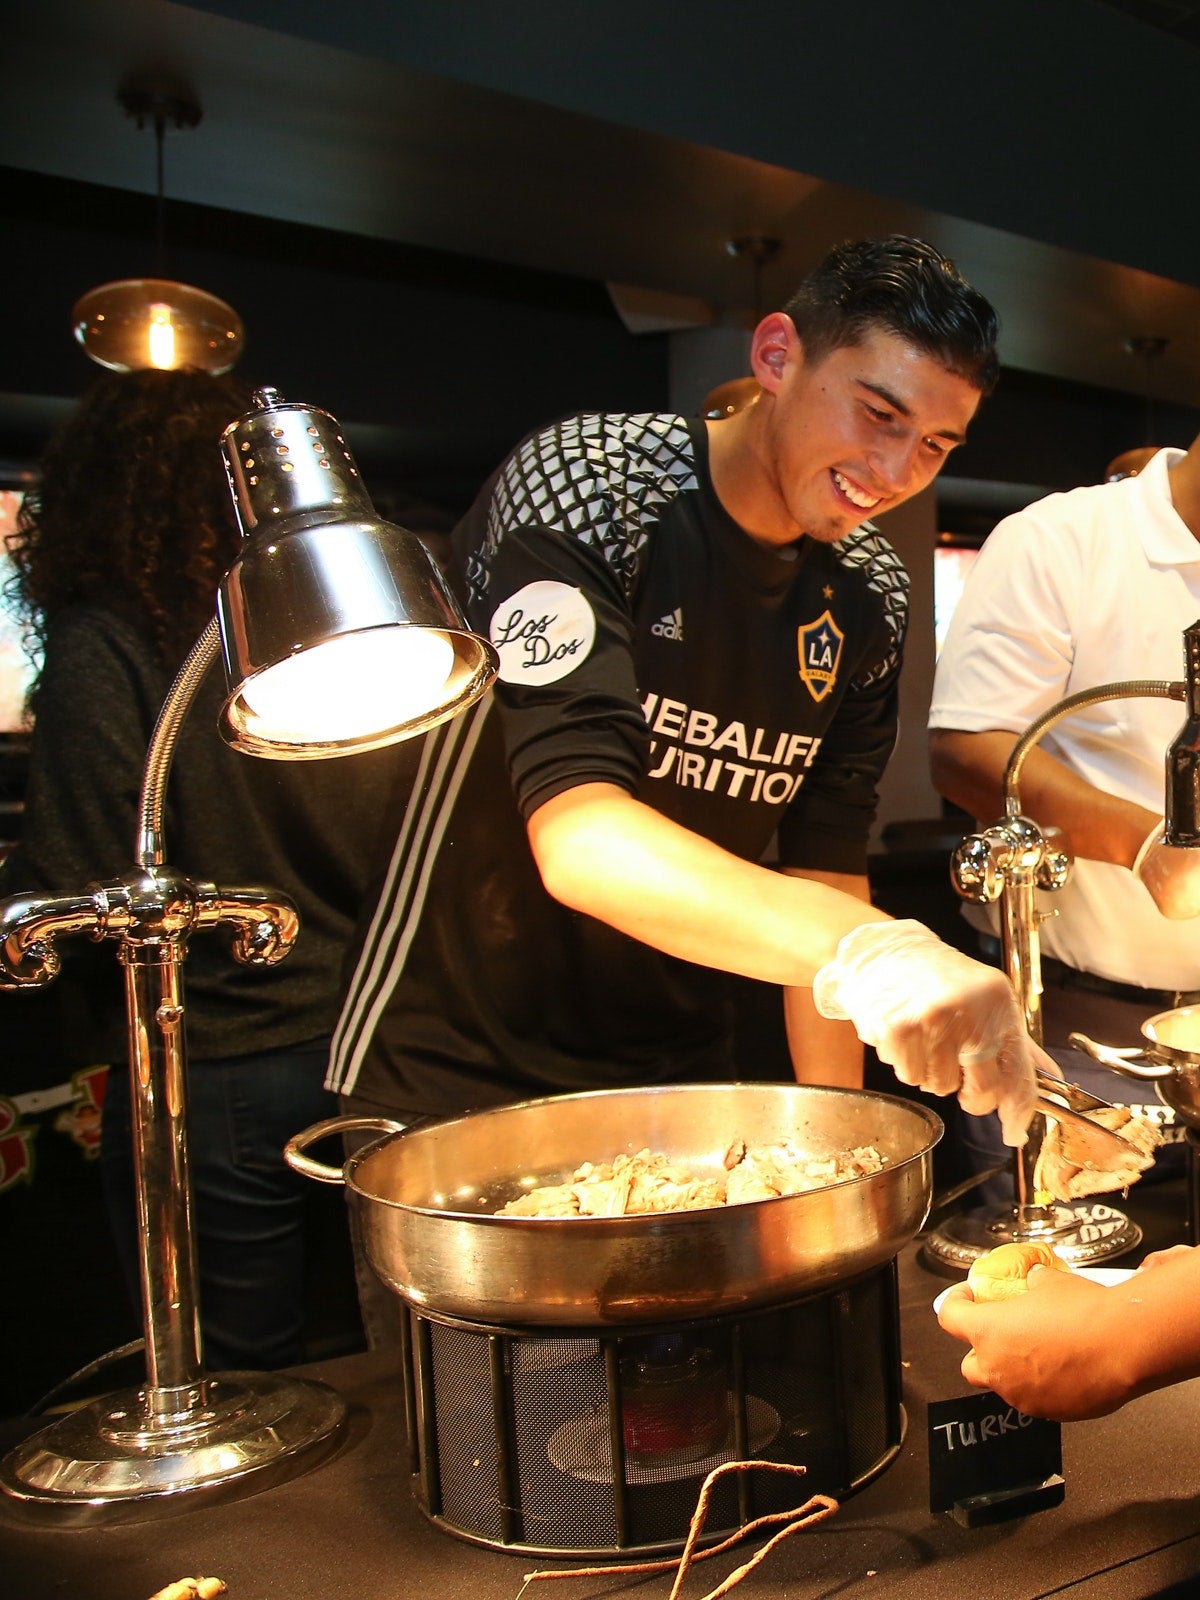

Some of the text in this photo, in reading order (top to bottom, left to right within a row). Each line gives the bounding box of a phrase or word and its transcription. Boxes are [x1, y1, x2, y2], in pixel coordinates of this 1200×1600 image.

[494, 609, 559, 648] Los
[522, 635, 585, 668] Dos
[808, 642, 832, 668] LA
[933, 1407, 1050, 1450] TURKE
